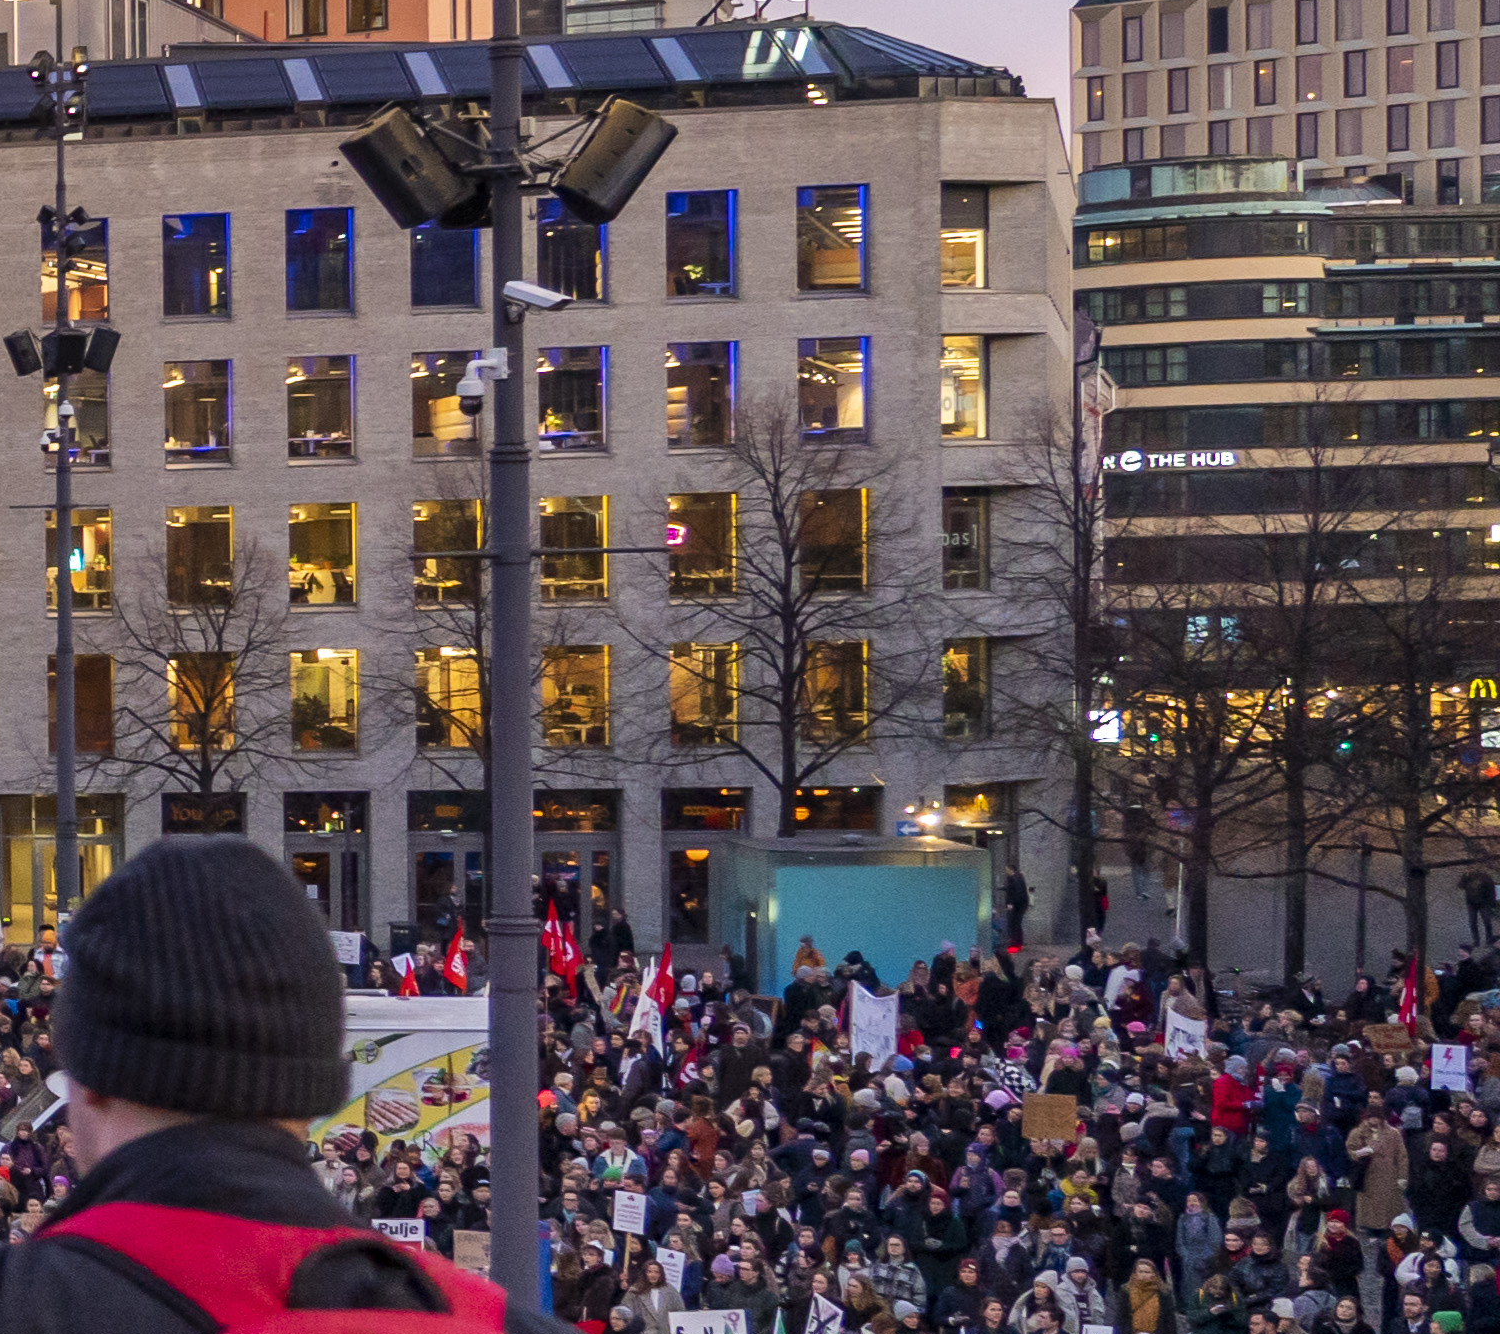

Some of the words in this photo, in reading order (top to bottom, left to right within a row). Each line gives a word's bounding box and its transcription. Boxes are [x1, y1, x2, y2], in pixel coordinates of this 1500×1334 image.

[1147, 453, 1187, 468] THE
[1191, 451, 1236, 467] HUB
[378, 1222, 419, 1238] Pulje
